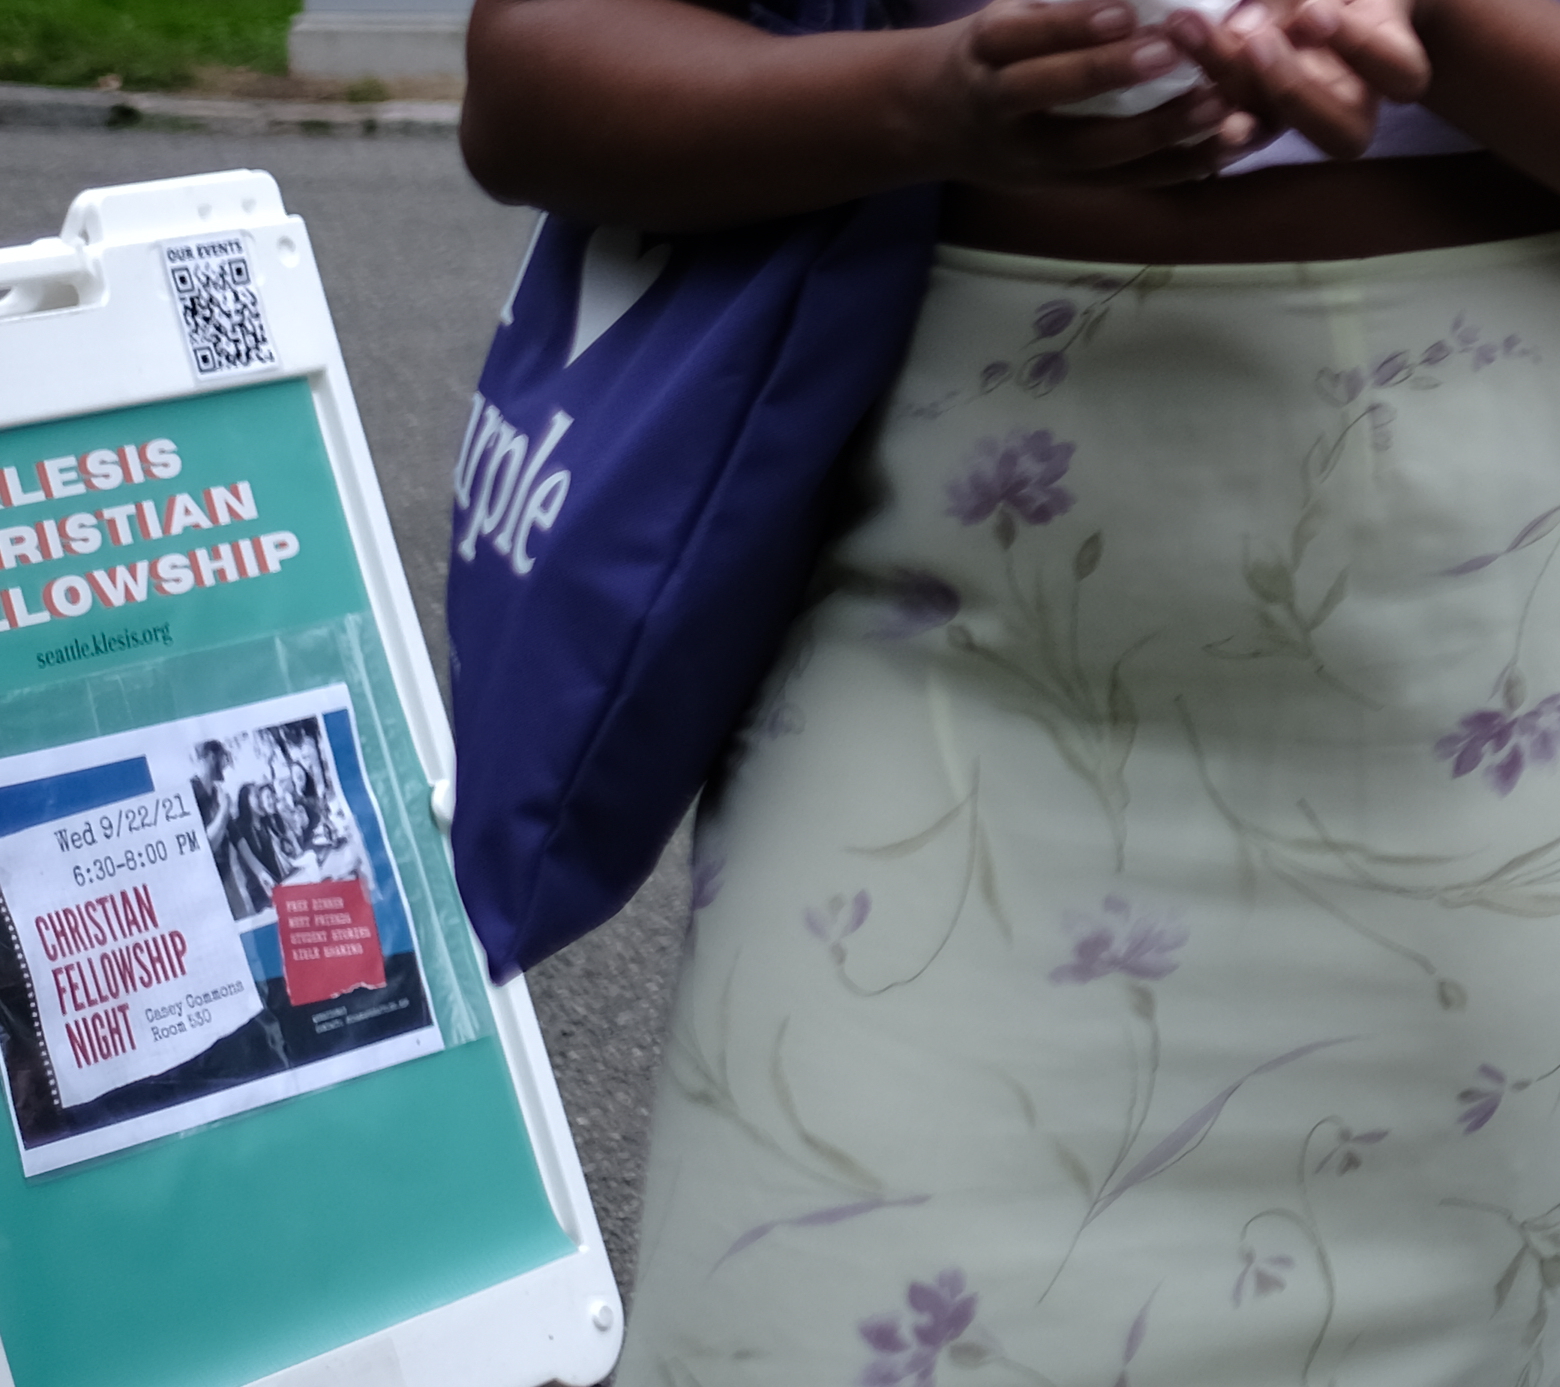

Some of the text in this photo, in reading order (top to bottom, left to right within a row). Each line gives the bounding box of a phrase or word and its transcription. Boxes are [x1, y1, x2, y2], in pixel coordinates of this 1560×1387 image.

[167, 238, 243, 263] OUR EVENTS
[0, 438, 182, 510] LESIS
[37, 622, 173, 669] seattle.klesis.org
[55, 793, 191, 853] Wed 9/22/21
[73, 831, 201, 887] 6:30-8:00 PM
[34, 883, 159, 962] CHRISTIAN
[52, 930, 188, 1016] FELLOWSHIP
[145, 980, 245, 1023] Casey Commons
[65, 1003, 137, 1069] NIGHT
[151, 1008, 213, 1043] Room 530
